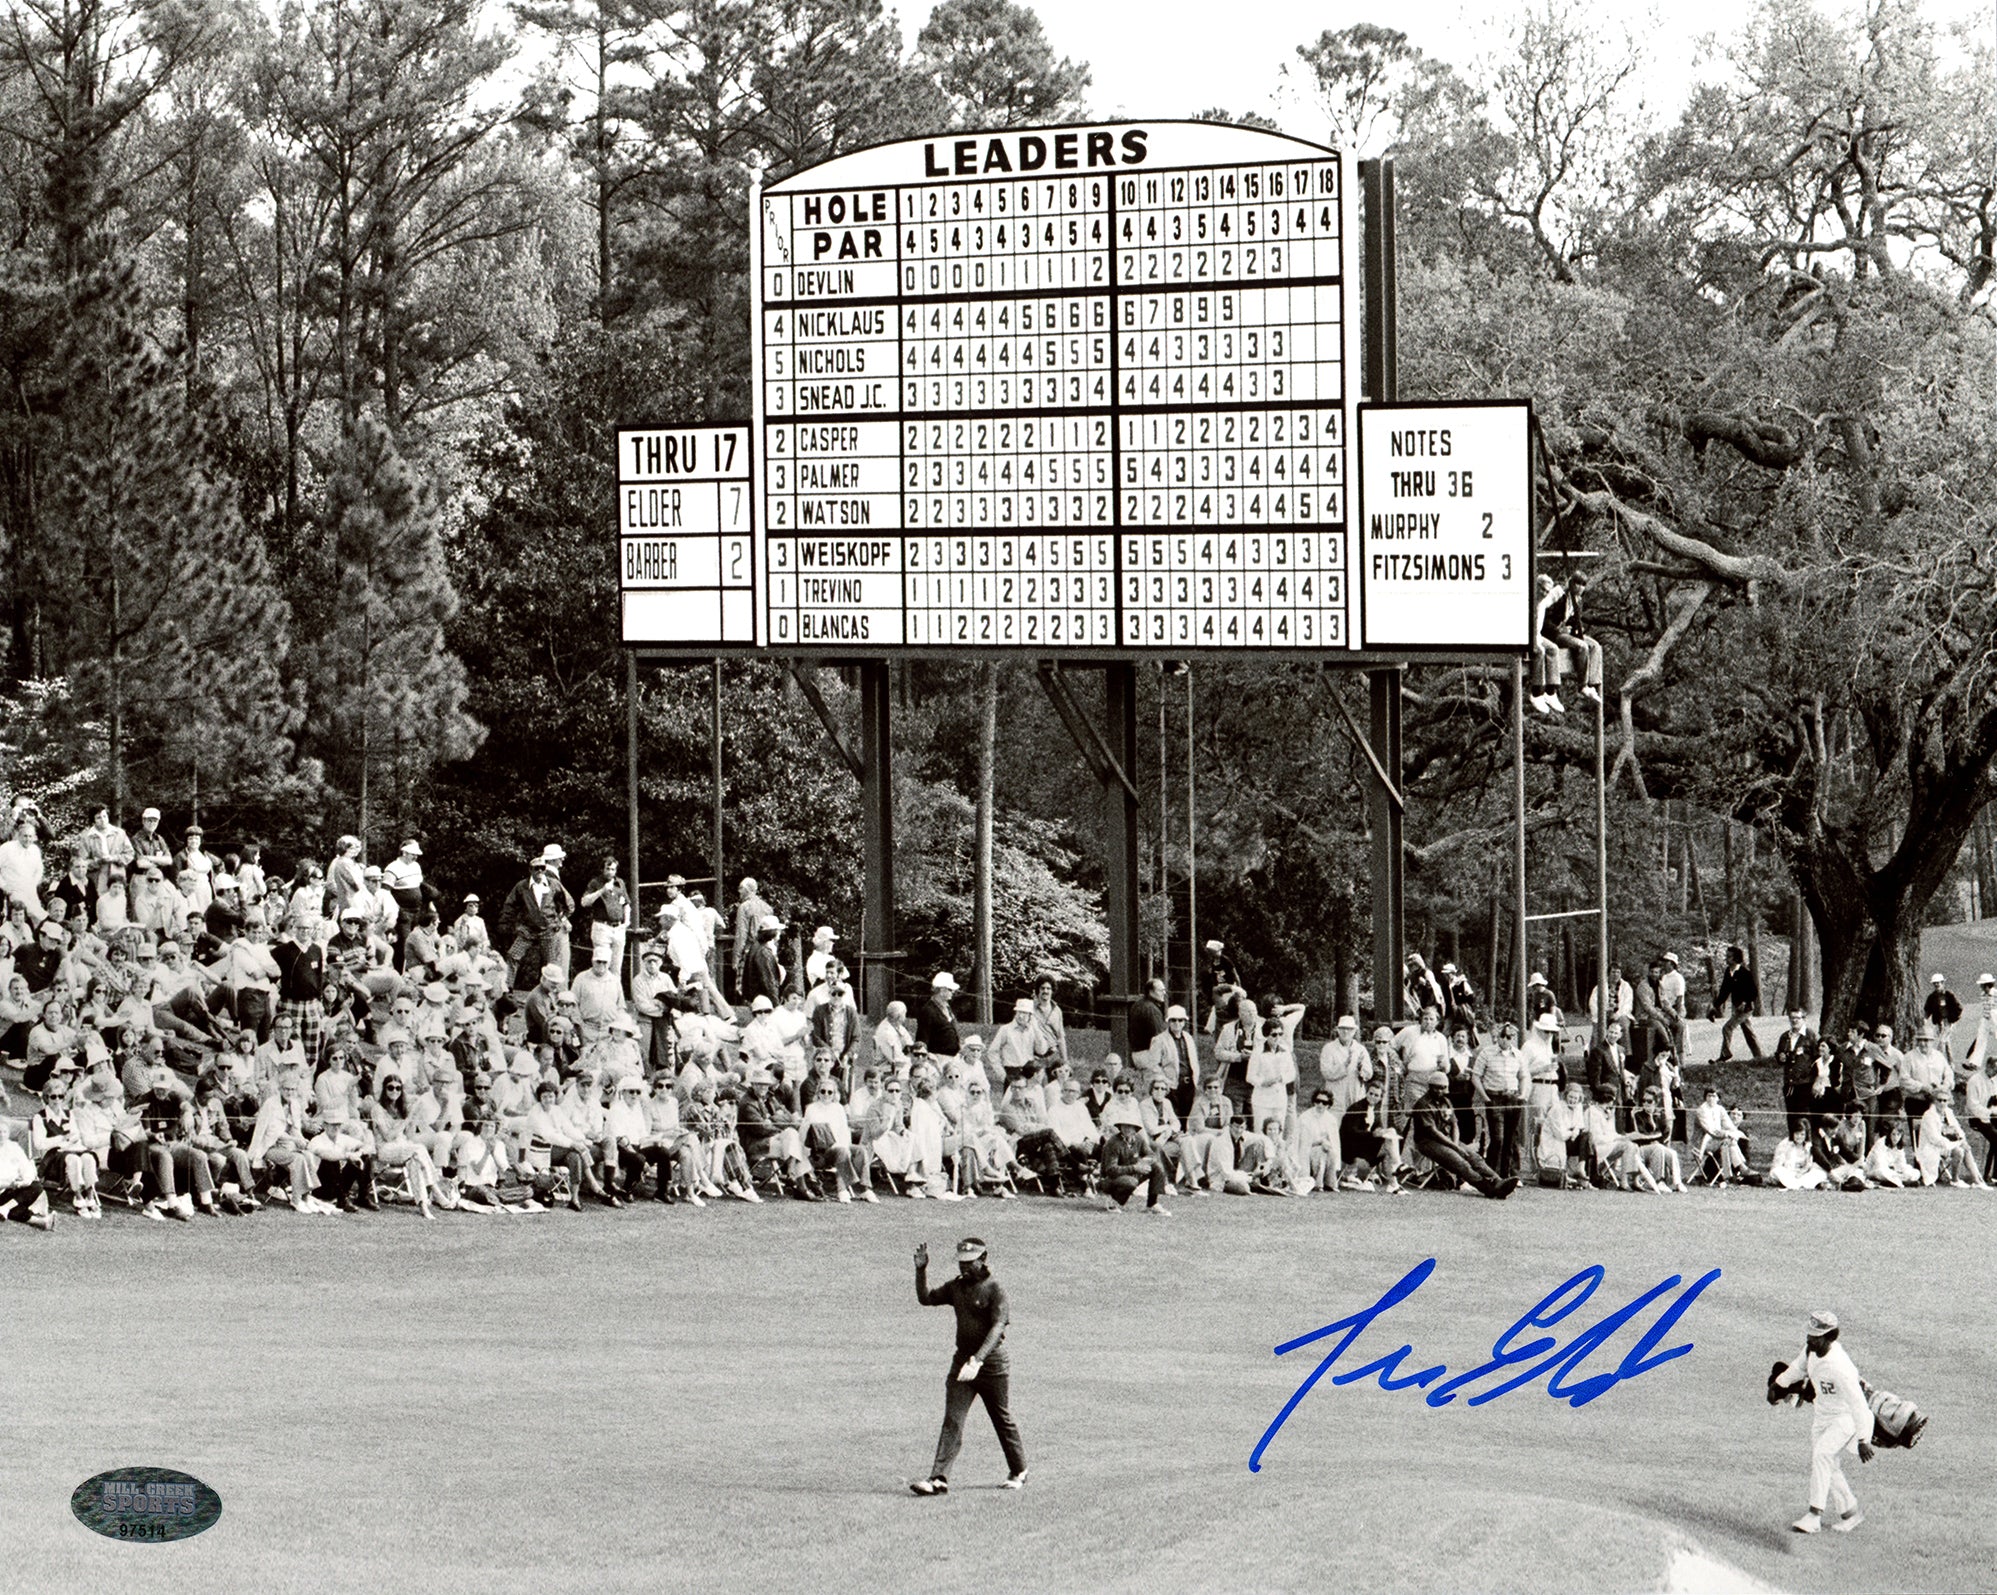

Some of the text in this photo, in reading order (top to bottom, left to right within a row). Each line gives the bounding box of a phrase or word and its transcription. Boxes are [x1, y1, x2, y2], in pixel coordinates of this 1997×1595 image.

[925, 129, 1148, 178] LEADERS
[805, 193, 886, 225] HOLE
[929, 192, 937, 217] 2
[952, 191, 960, 216] 3
[974, 189, 983, 213] 4
[998, 188, 1006, 212] 5
[1021, 186, 1029, 211] 6
[1046, 185, 1054, 209] 7
[1069, 183, 1077, 208] 8
[1092, 182, 1100, 208] 9
[1121, 180, 1136, 206] 10
[1146, 180, 1157, 204] 11
[1170, 177, 1184, 202] 12
[1195, 176, 1209, 201] 13
[1220, 174, 1236, 200] 14
[1244, 173, 1259, 198] 15
[1269, 171, 1283, 196] 16
[1294, 170, 1308, 195] 17
[1319, 168, 1334, 194] 18
[765, 199, 788, 262] PRIOR
[814, 206, 1331, 260] PAR 4 5 4 3 4 3 4 5 4 4 4 3 5 4 5 3 4 4
[774, 270, 853, 296] 0 DEVLIN
[774, 295, 1233, 337] 4 NICKLAUS 4 4 4 4 4 5 6 6 6 6 7 8 9 9
[776, 348, 864, 374] 5 NICHOLS
[776, 384, 886, 410] 3 SNEAD J.C.
[631, 433, 737, 474] THRU 17
[776, 427, 858, 452] 2 CASPER
[1391, 430, 1452, 457] NOTES
[776, 453, 1337, 489] 3 PALMER 2 3 3 4 4 4 5 5 5 5 4 3 3 3 4 4 4 4
[1391, 470, 1474, 498] THRU 36
[628, 487, 741, 528] ELDER 7
[777, 492, 1338, 524] 2 WATSON 2 2 3 3 3 3 3 3 2 2 2 2 4 3 4 4 5 4
[1371, 512, 1493, 540] MURPHY 2
[626, 541, 743, 580] BARBER 2
[778, 538, 1337, 567] 3 WEISKOPF 2 3 3 3 3 4 5 5 5 5 5 5 4 4 3 3 3 3
[1373, 554, 1512, 581] FITZSIMONS 3
[804, 579, 861, 602] TREVINO
[779, 614, 868, 639] 0 BLANCAS
